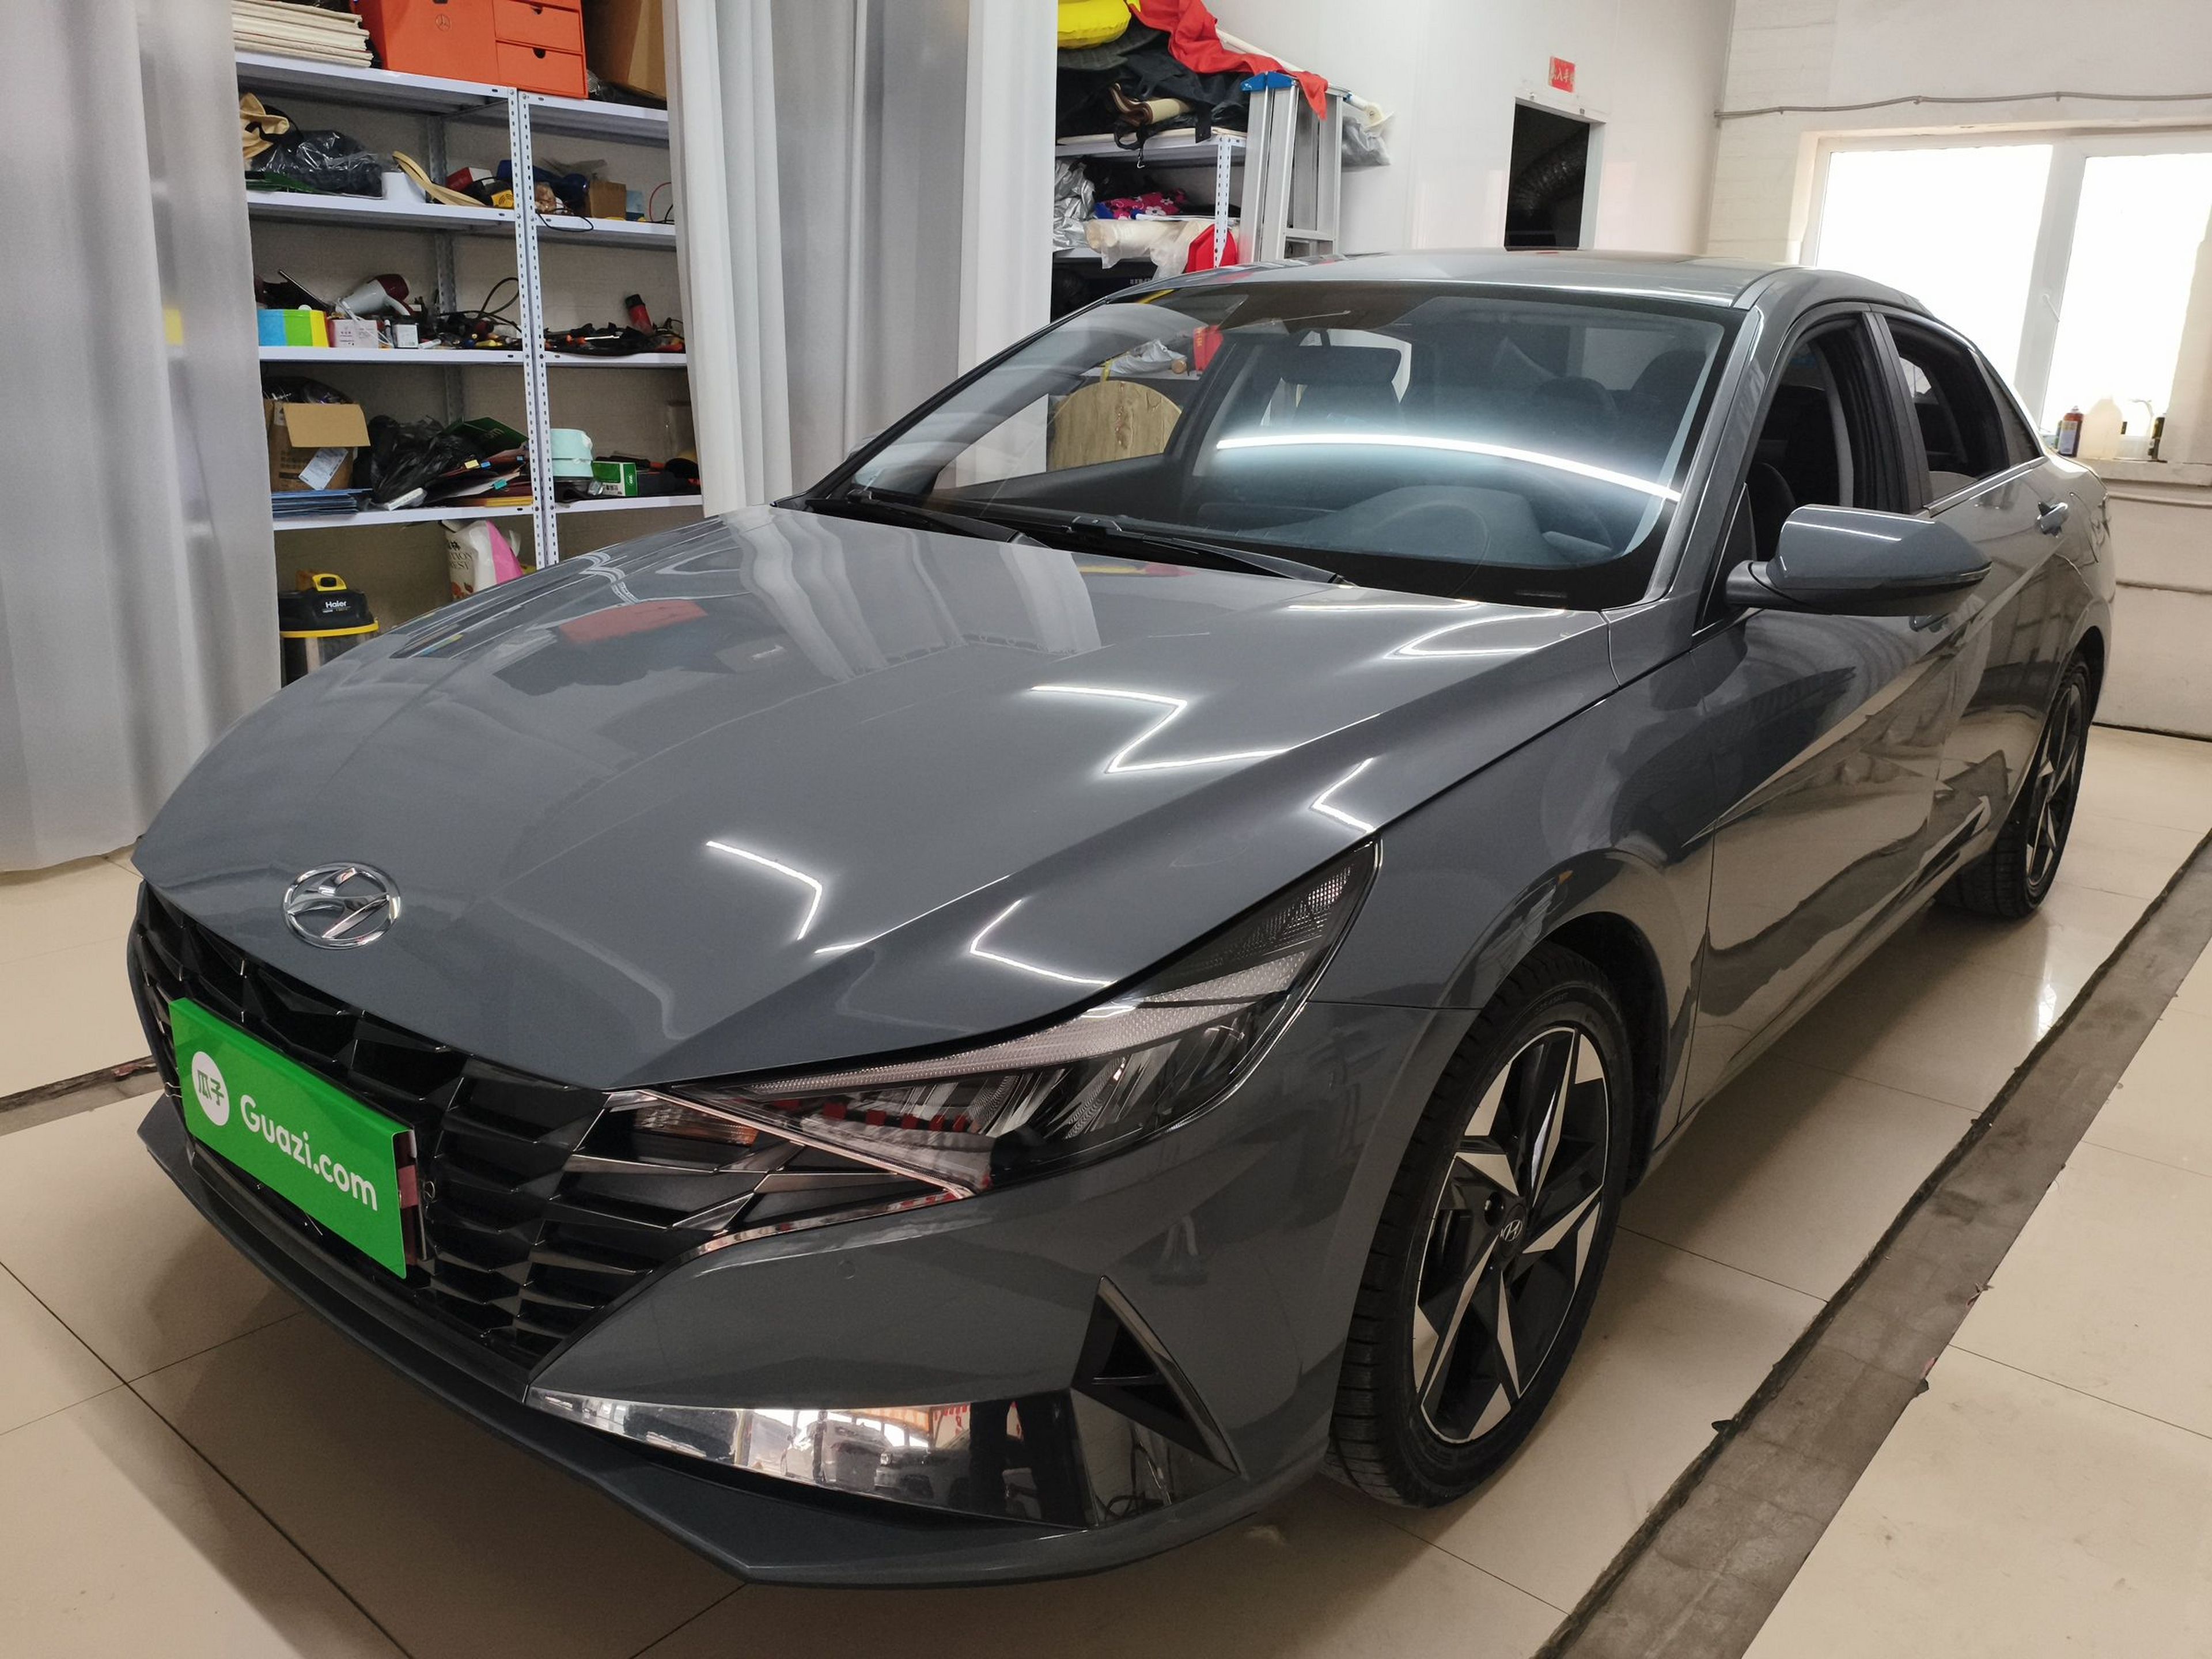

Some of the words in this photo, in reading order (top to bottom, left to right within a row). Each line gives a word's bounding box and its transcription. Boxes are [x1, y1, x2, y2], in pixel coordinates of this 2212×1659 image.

[325, 600, 347, 608] Haier
[197, 1070, 224, 1106] 瓜子
[241, 1094, 377, 1211] Guazi.com
